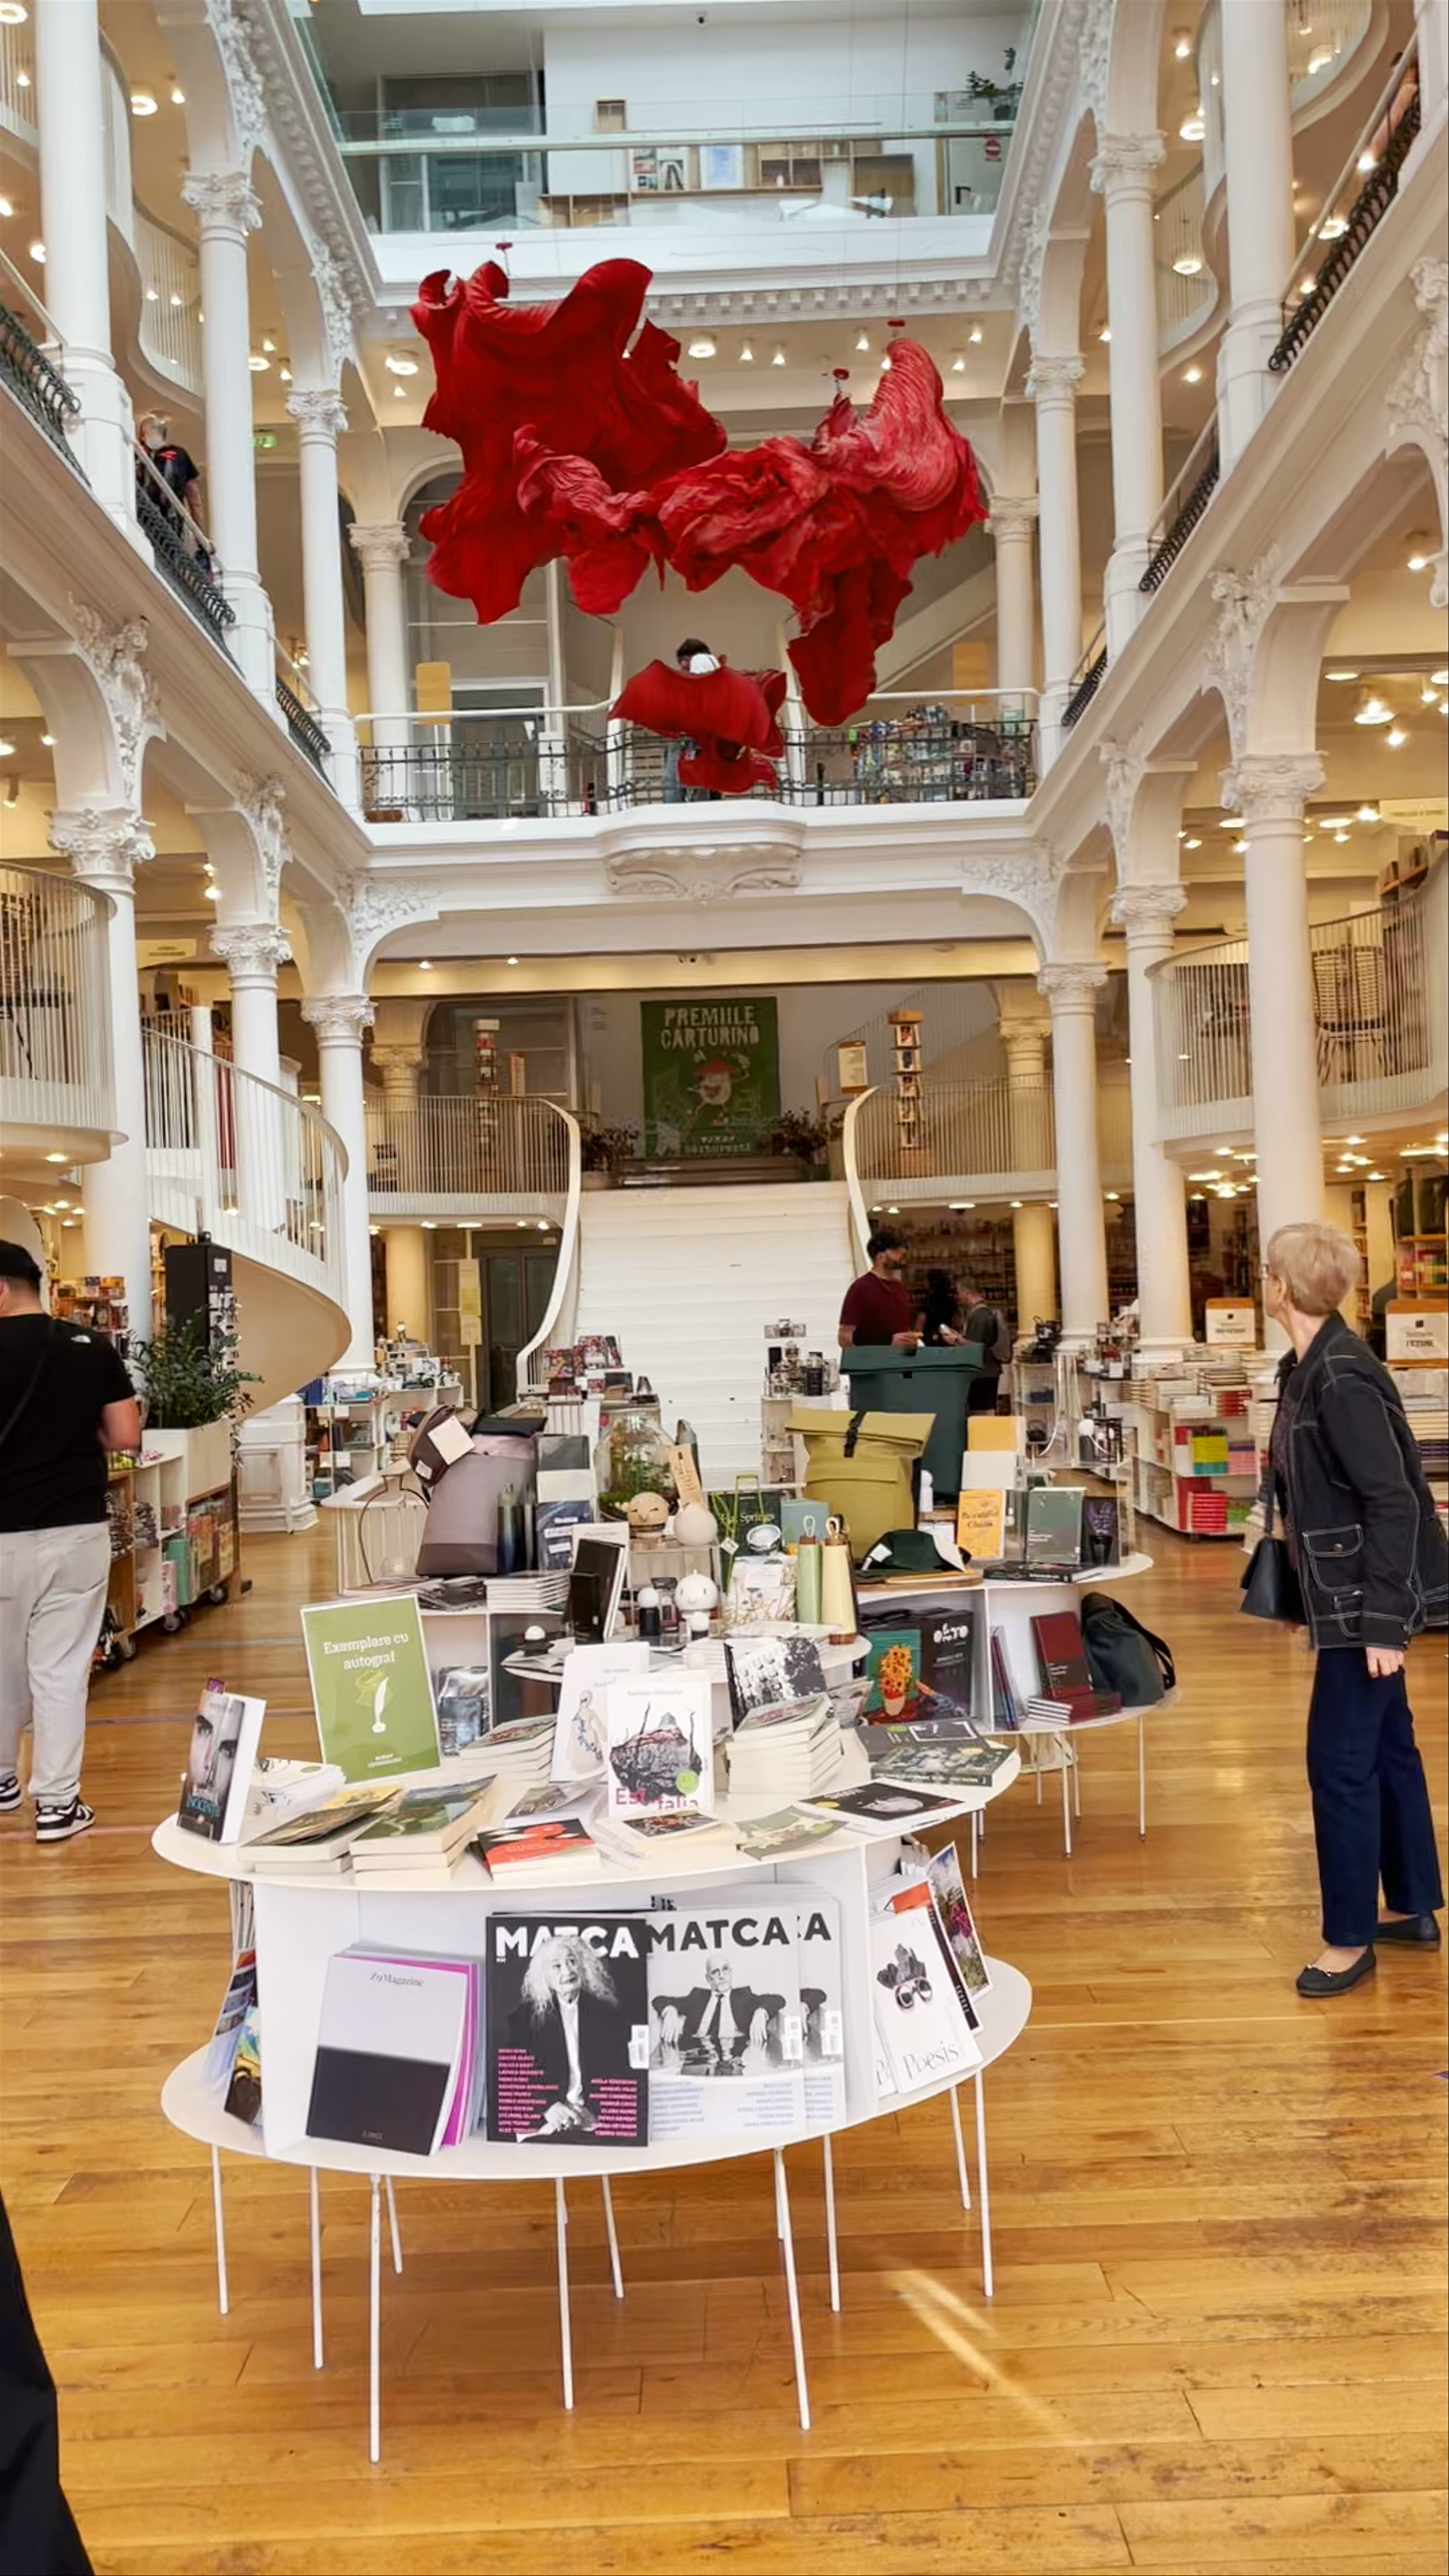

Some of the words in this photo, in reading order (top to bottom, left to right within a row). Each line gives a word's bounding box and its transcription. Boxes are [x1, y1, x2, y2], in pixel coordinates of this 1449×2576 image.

[665, 1005, 755, 1027] PREMIILE
[323, 1636, 391, 1655] Exemplare
[393, 1633, 409, 1645] cu
[343, 1650, 395, 1670] autograf
[647, 1917, 790, 1953] MATCA
[902, 2041, 959, 2081] Poesis
